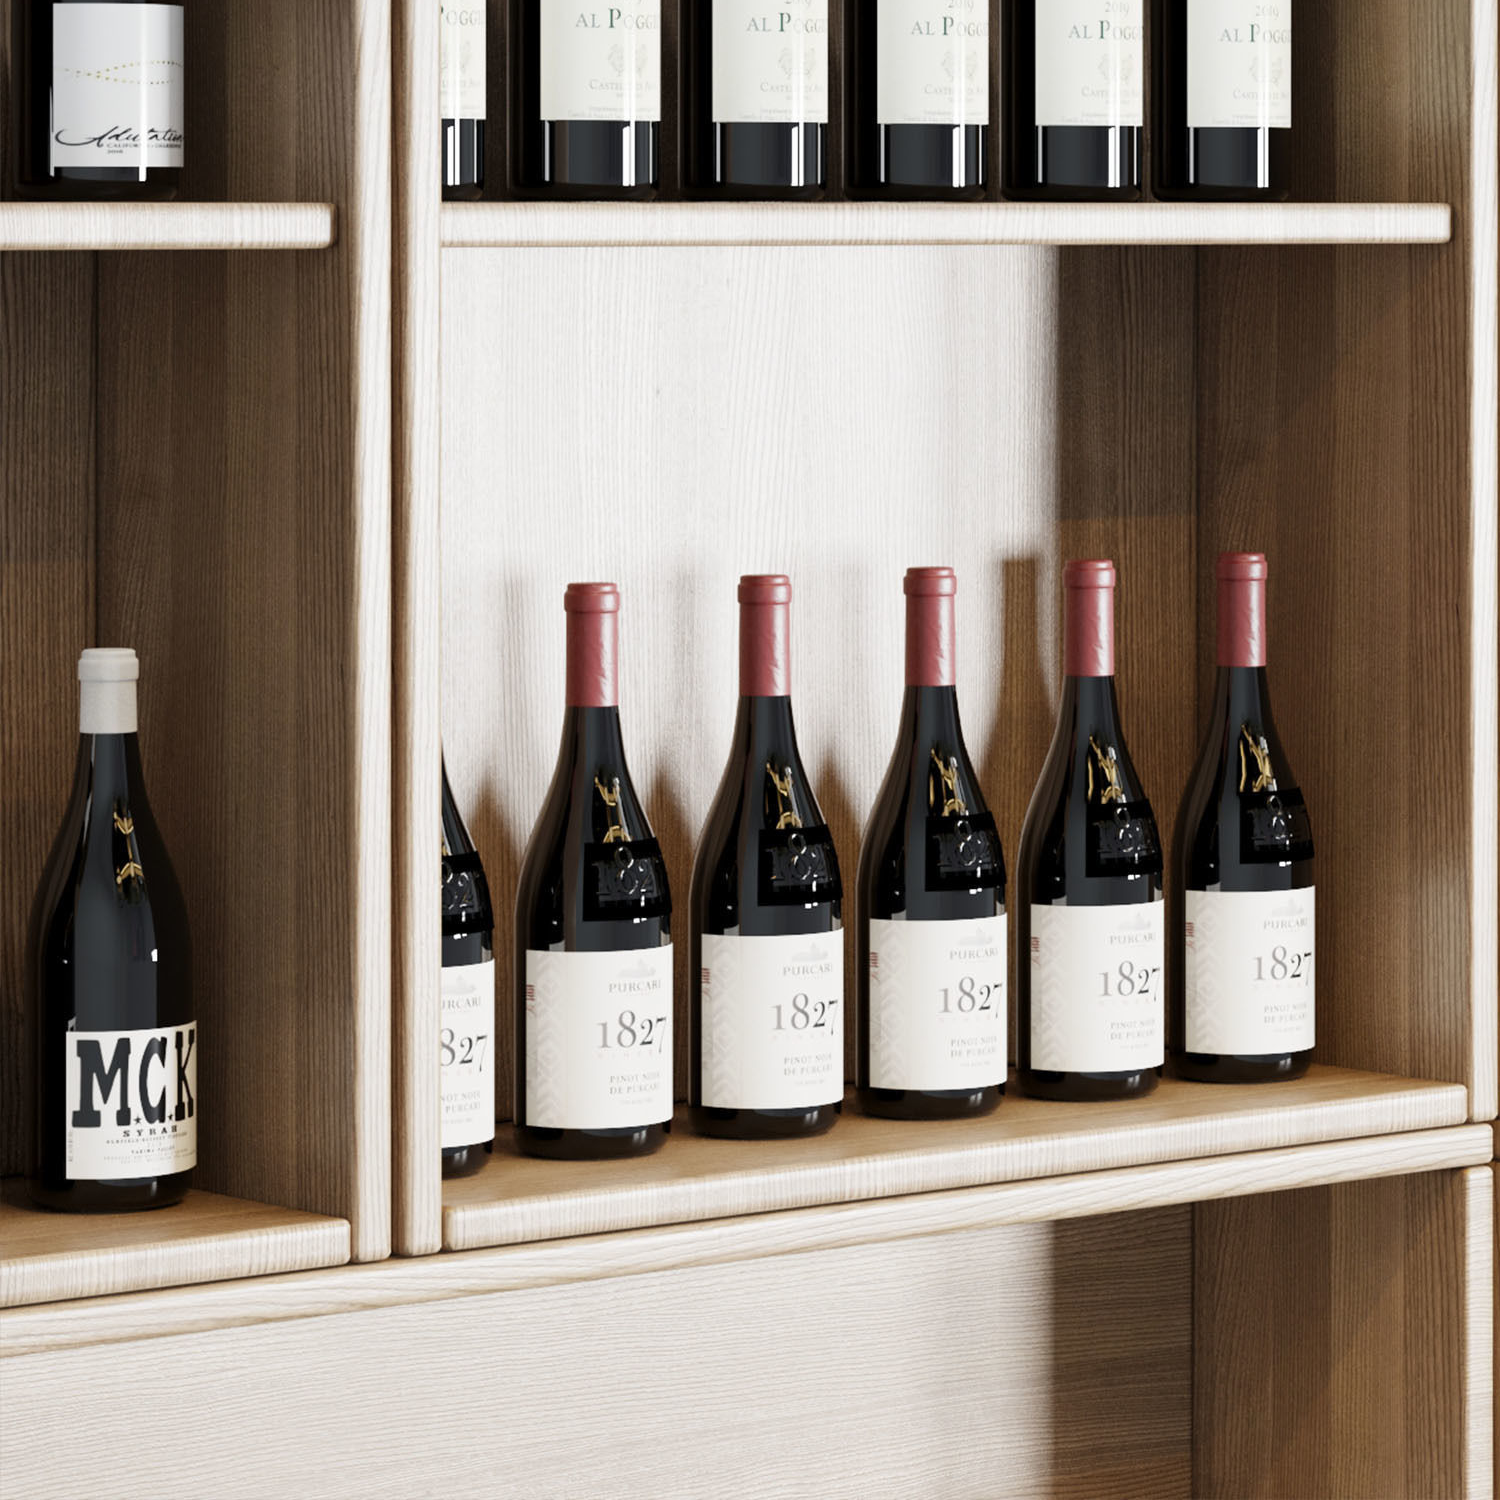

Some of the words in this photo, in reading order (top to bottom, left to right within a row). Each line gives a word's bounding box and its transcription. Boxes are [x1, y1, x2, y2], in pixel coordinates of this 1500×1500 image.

[1104, 1, 1130, 16] 2019
[1255, 5, 1279, 19] 2019
[575, 13, 600, 29] AL
[746, 17, 772, 32] AL
[911, 21, 935, 36] AL
[1068, 24, 1092, 39] AL
[1220, 28, 1243, 43] AL
[1252, 945, 1312, 987] 1827
[1099, 959, 1160, 1002] 1827
[938, 975, 1003, 1019] 1827
[772, 992, 838, 1036] 1827
[597, 1009, 667, 1054] 1827
[122, 1125, 178, 1138] SYRAH
